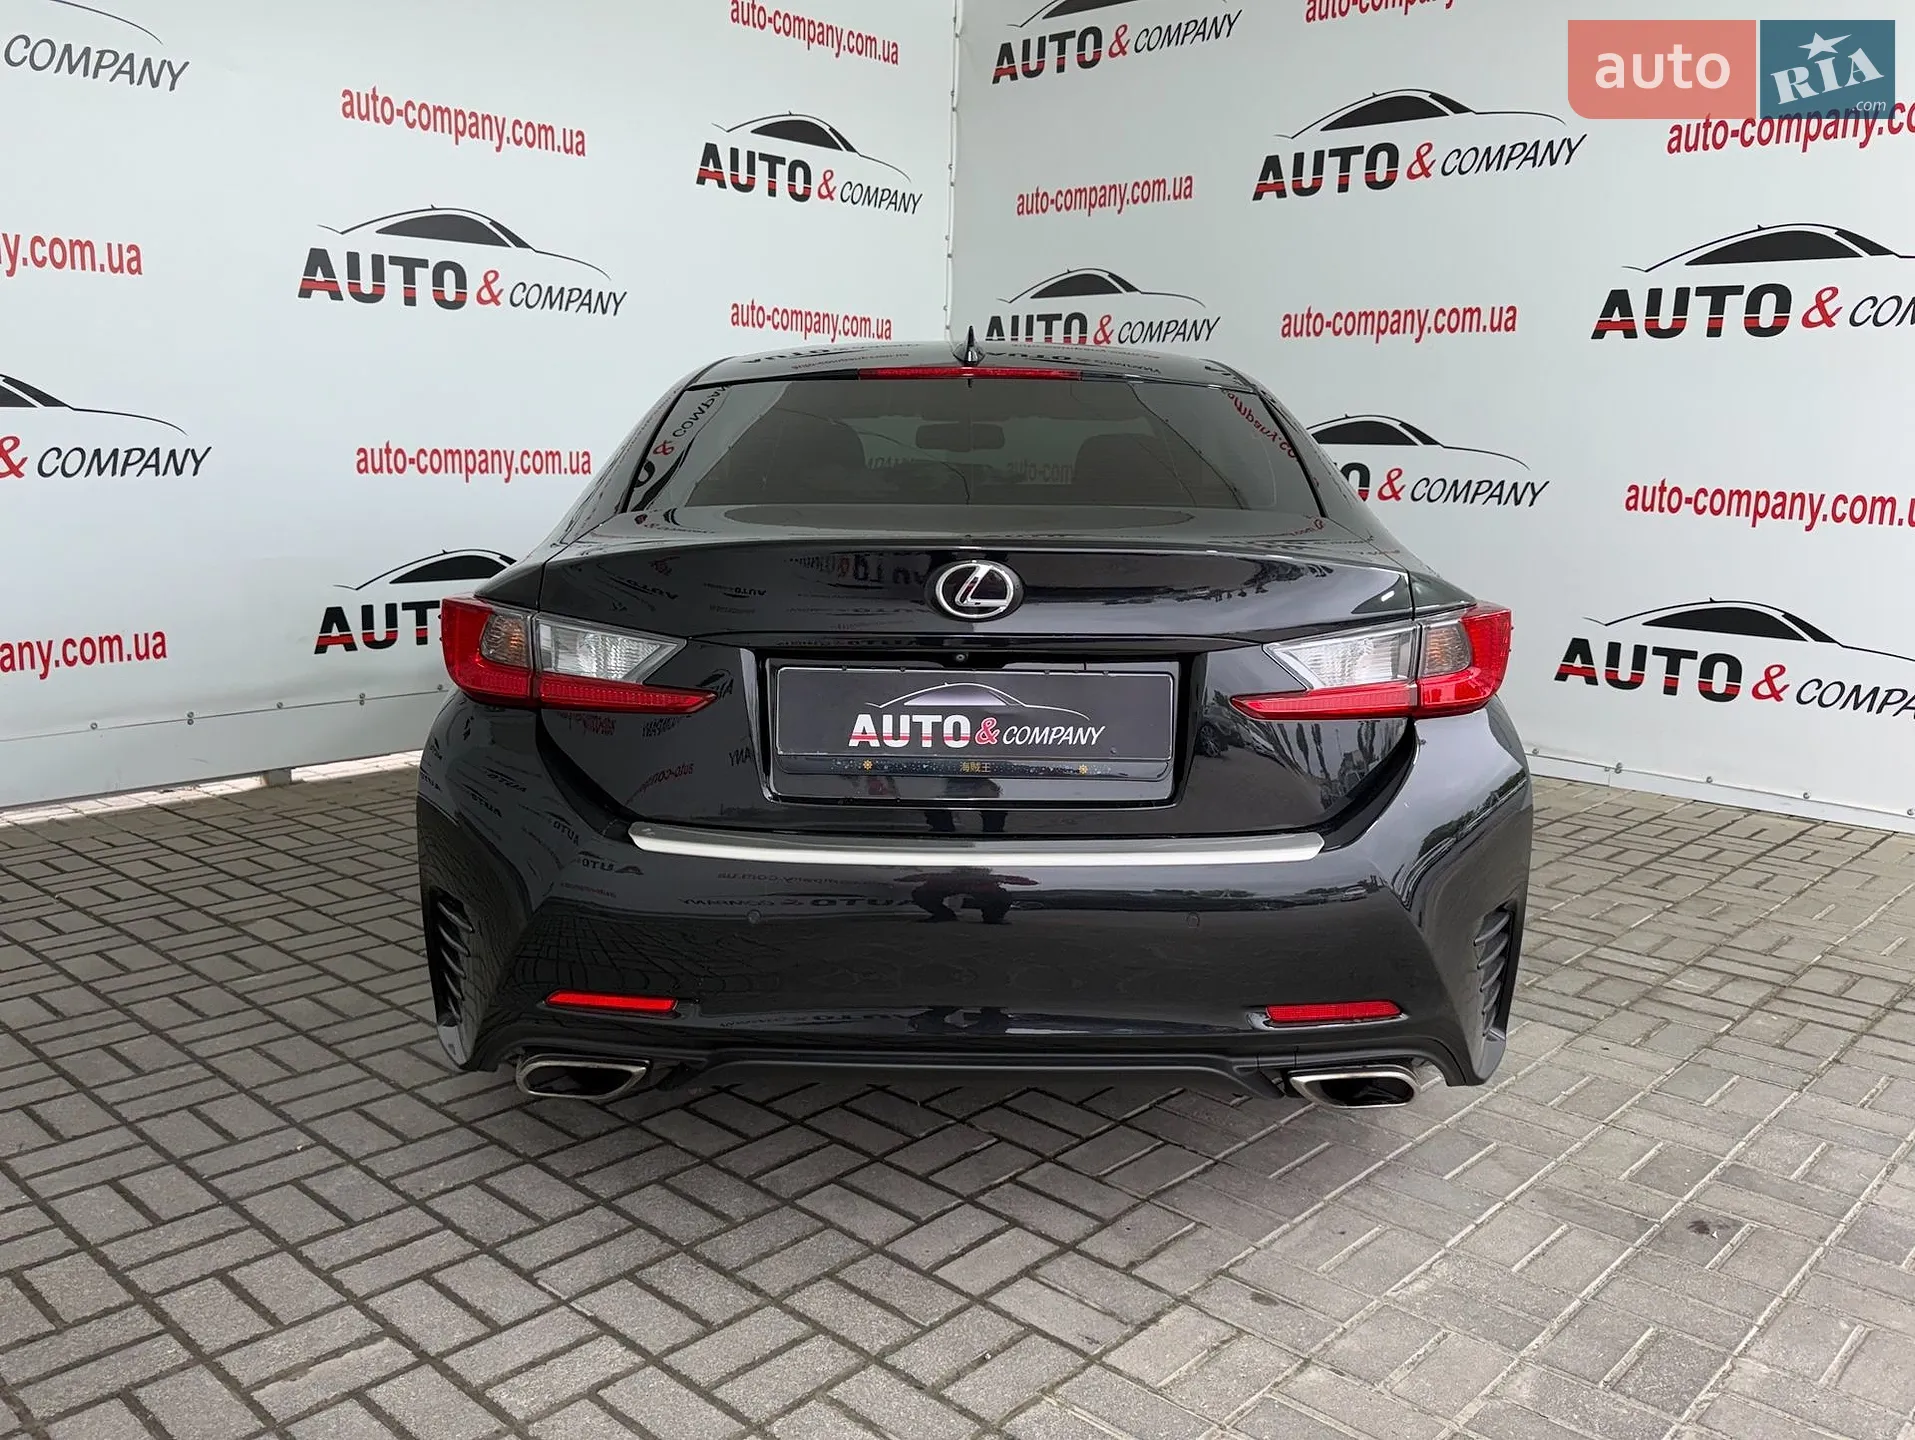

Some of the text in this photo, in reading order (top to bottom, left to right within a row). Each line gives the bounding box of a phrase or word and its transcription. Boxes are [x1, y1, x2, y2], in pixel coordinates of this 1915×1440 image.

[731, 0, 898, 65] auto-company.com.ua
[992, 9, 1242, 84] AUTO & COMPANY
[4, 34, 190, 91] COMPANY
[341, 86, 586, 157] auto-company.com.ua
[695, 142, 923, 214] AUTO & COMPANY
[1016, 172, 1194, 216] auto-company.com.ua
[1252, 134, 1587, 201] AUTO & COMPANY
[0, 232, 143, 278] y.com.ua
[297, 247, 627, 316] AUTO & COMPANY
[731, 299, 892, 343] auto-company.com.ua
[985, 312, 1220, 345] AUTO & COMPANY
[1281, 305, 1517, 344] auto-company.com.ua
[1591, 283, 1792, 340] AUTO
[1801, 286, 1843, 328] &
[37, 446, 212, 478] COMPANY
[356, 440, 592, 484] auto-company.com.ua
[1377, 468, 1406, 502] &
[1410, 477, 1550, 507] COMPANY
[314, 600, 441, 654] AUT
[1553, 637, 1744, 703] AUTO
[1751, 664, 1790, 702] &
[848, 714, 1105, 748] AUTO & COMPANY
